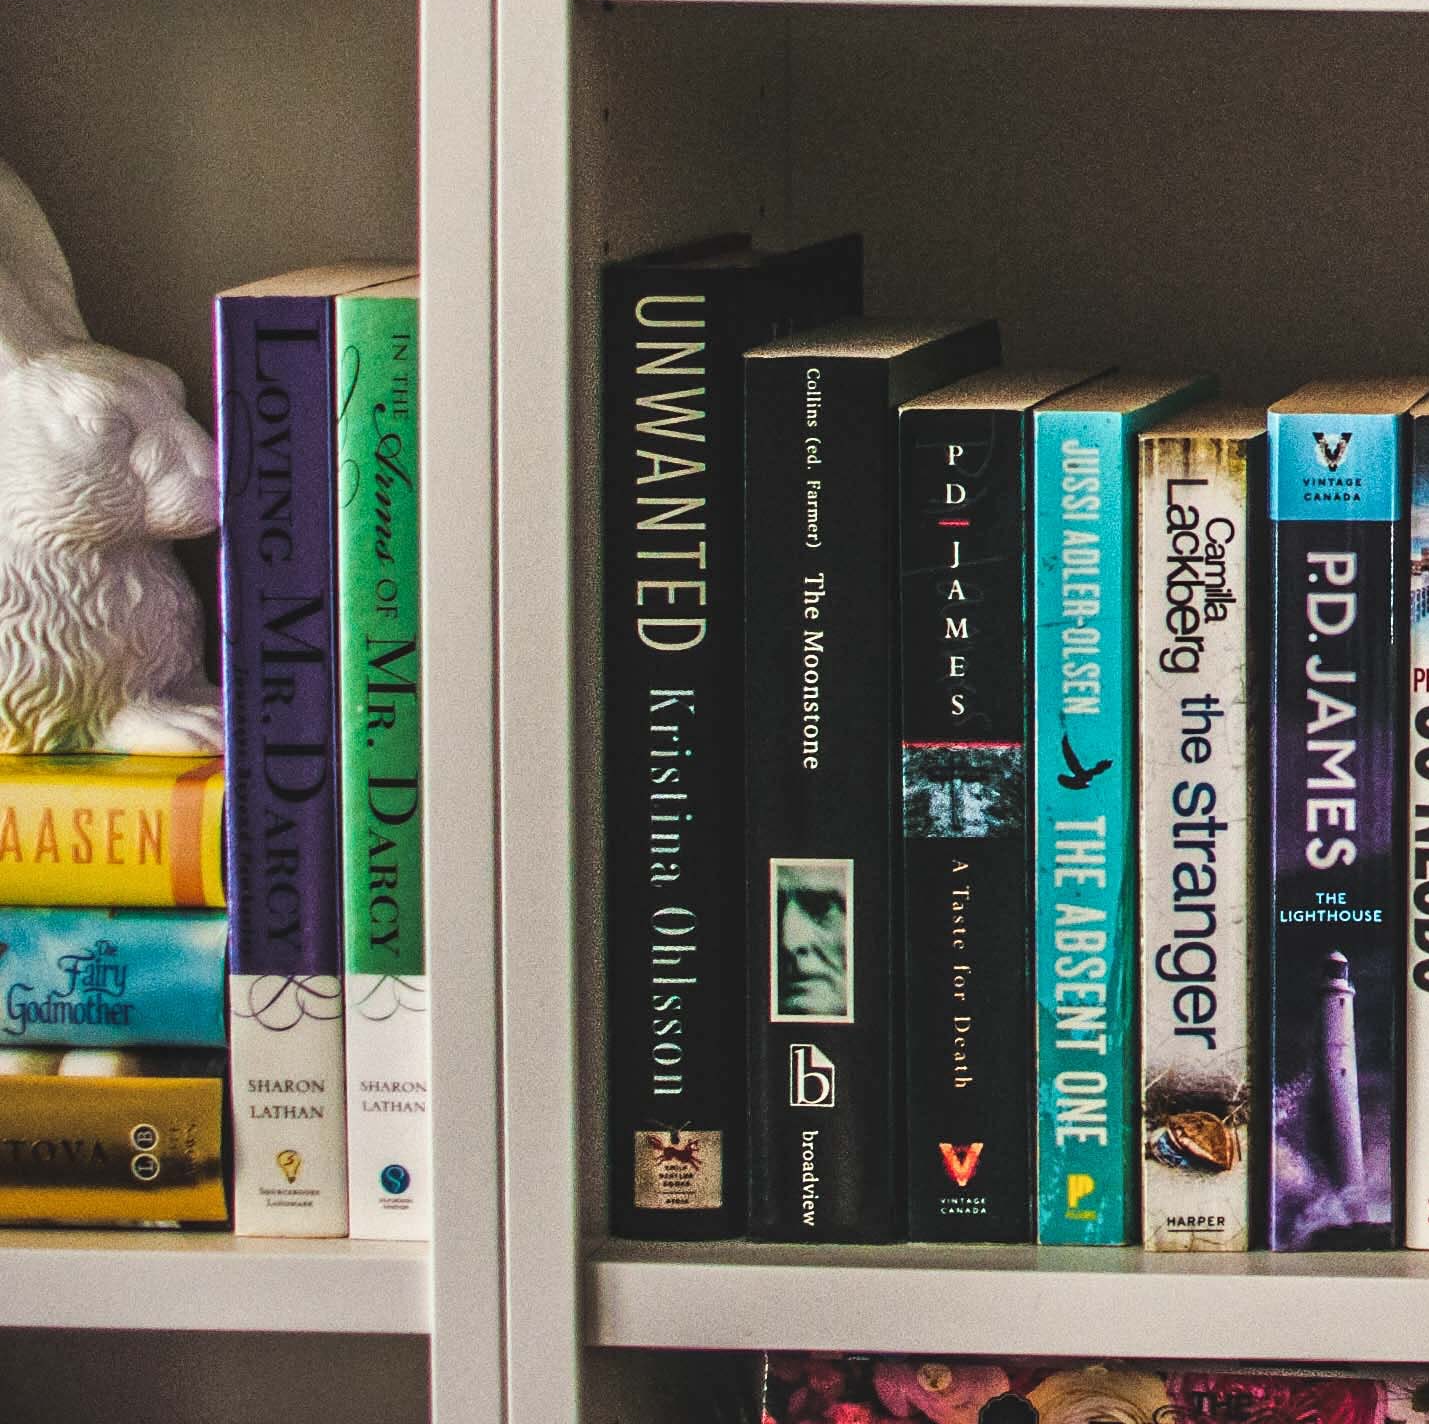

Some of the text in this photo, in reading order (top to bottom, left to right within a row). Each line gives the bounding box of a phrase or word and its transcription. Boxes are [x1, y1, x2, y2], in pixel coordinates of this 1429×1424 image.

[635, 295, 707, 652] UNWANTED
[1303, 478, 1362, 487] VINTAGE
[1303, 492, 1361, 501] CANADA
[802, 572, 826, 770] The Moonstone
[1154, 781, 1229, 1051] stranger
[1279, 909, 1383, 923] LIGHTHOUSE
[651, 906, 697, 1096] Ohlsson
[1054, 815, 1106, 1147] THE ABSENT ONE
[248, 1079, 326, 1095] SHARON
[249, 1104, 324, 1120] LATHAN
[801, 1129, 819, 1227] broadview
[1167, 1216, 1225, 1227] HARPER
